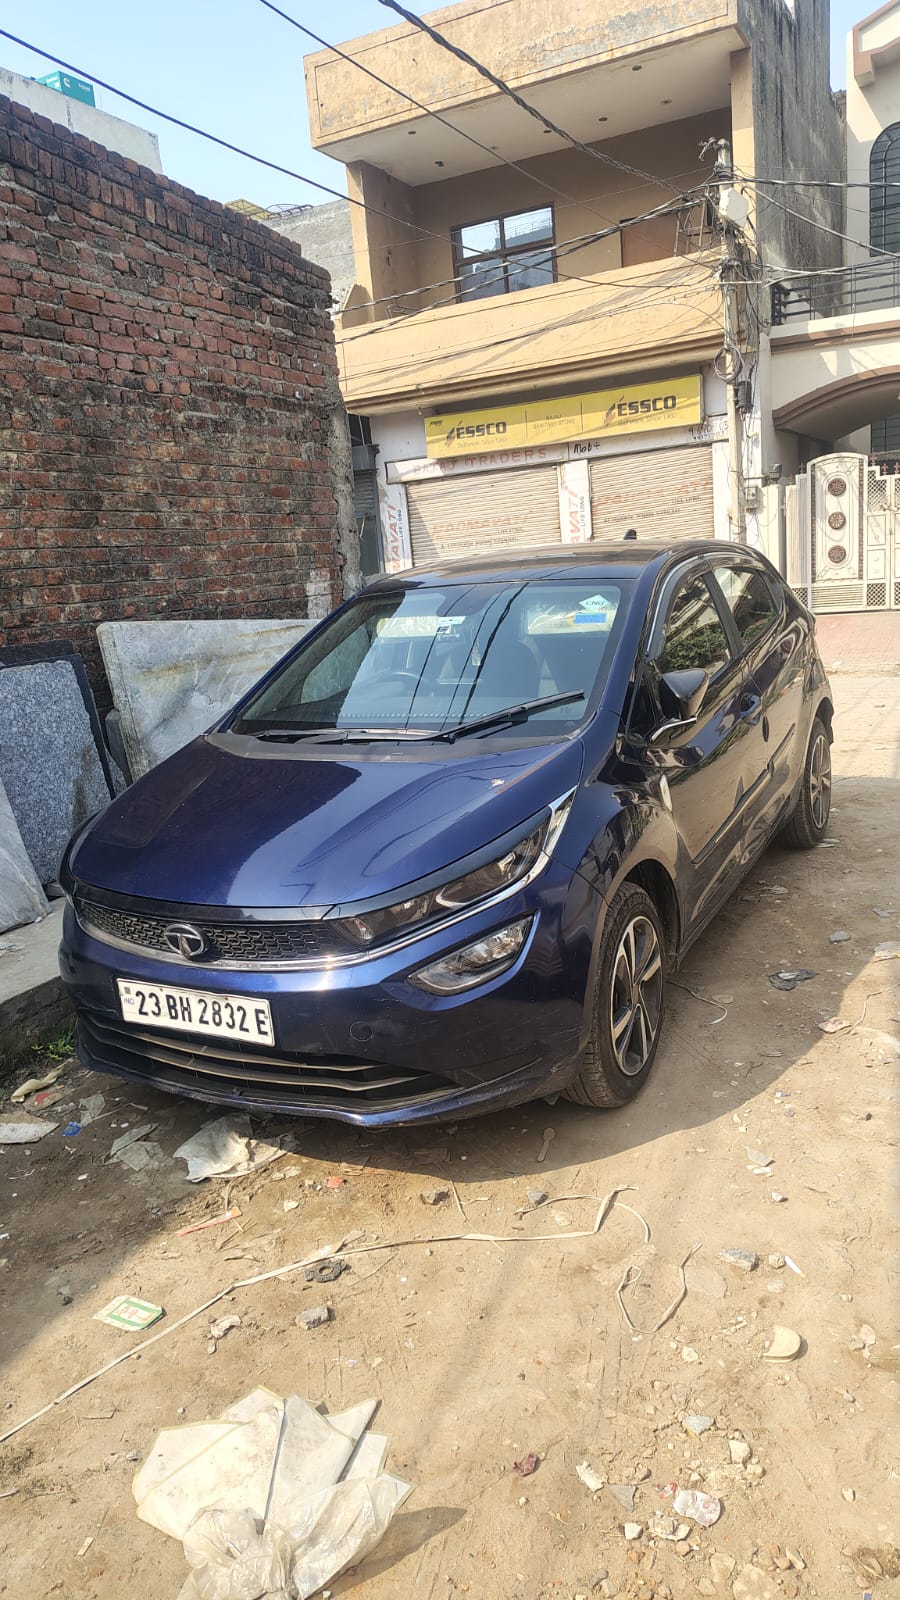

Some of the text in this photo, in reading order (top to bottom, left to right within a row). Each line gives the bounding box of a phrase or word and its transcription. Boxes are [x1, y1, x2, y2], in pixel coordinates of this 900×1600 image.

[465, 448, 547, 467] TRADERS
[135, 990, 269, 1036] 23 BH 2832 E
